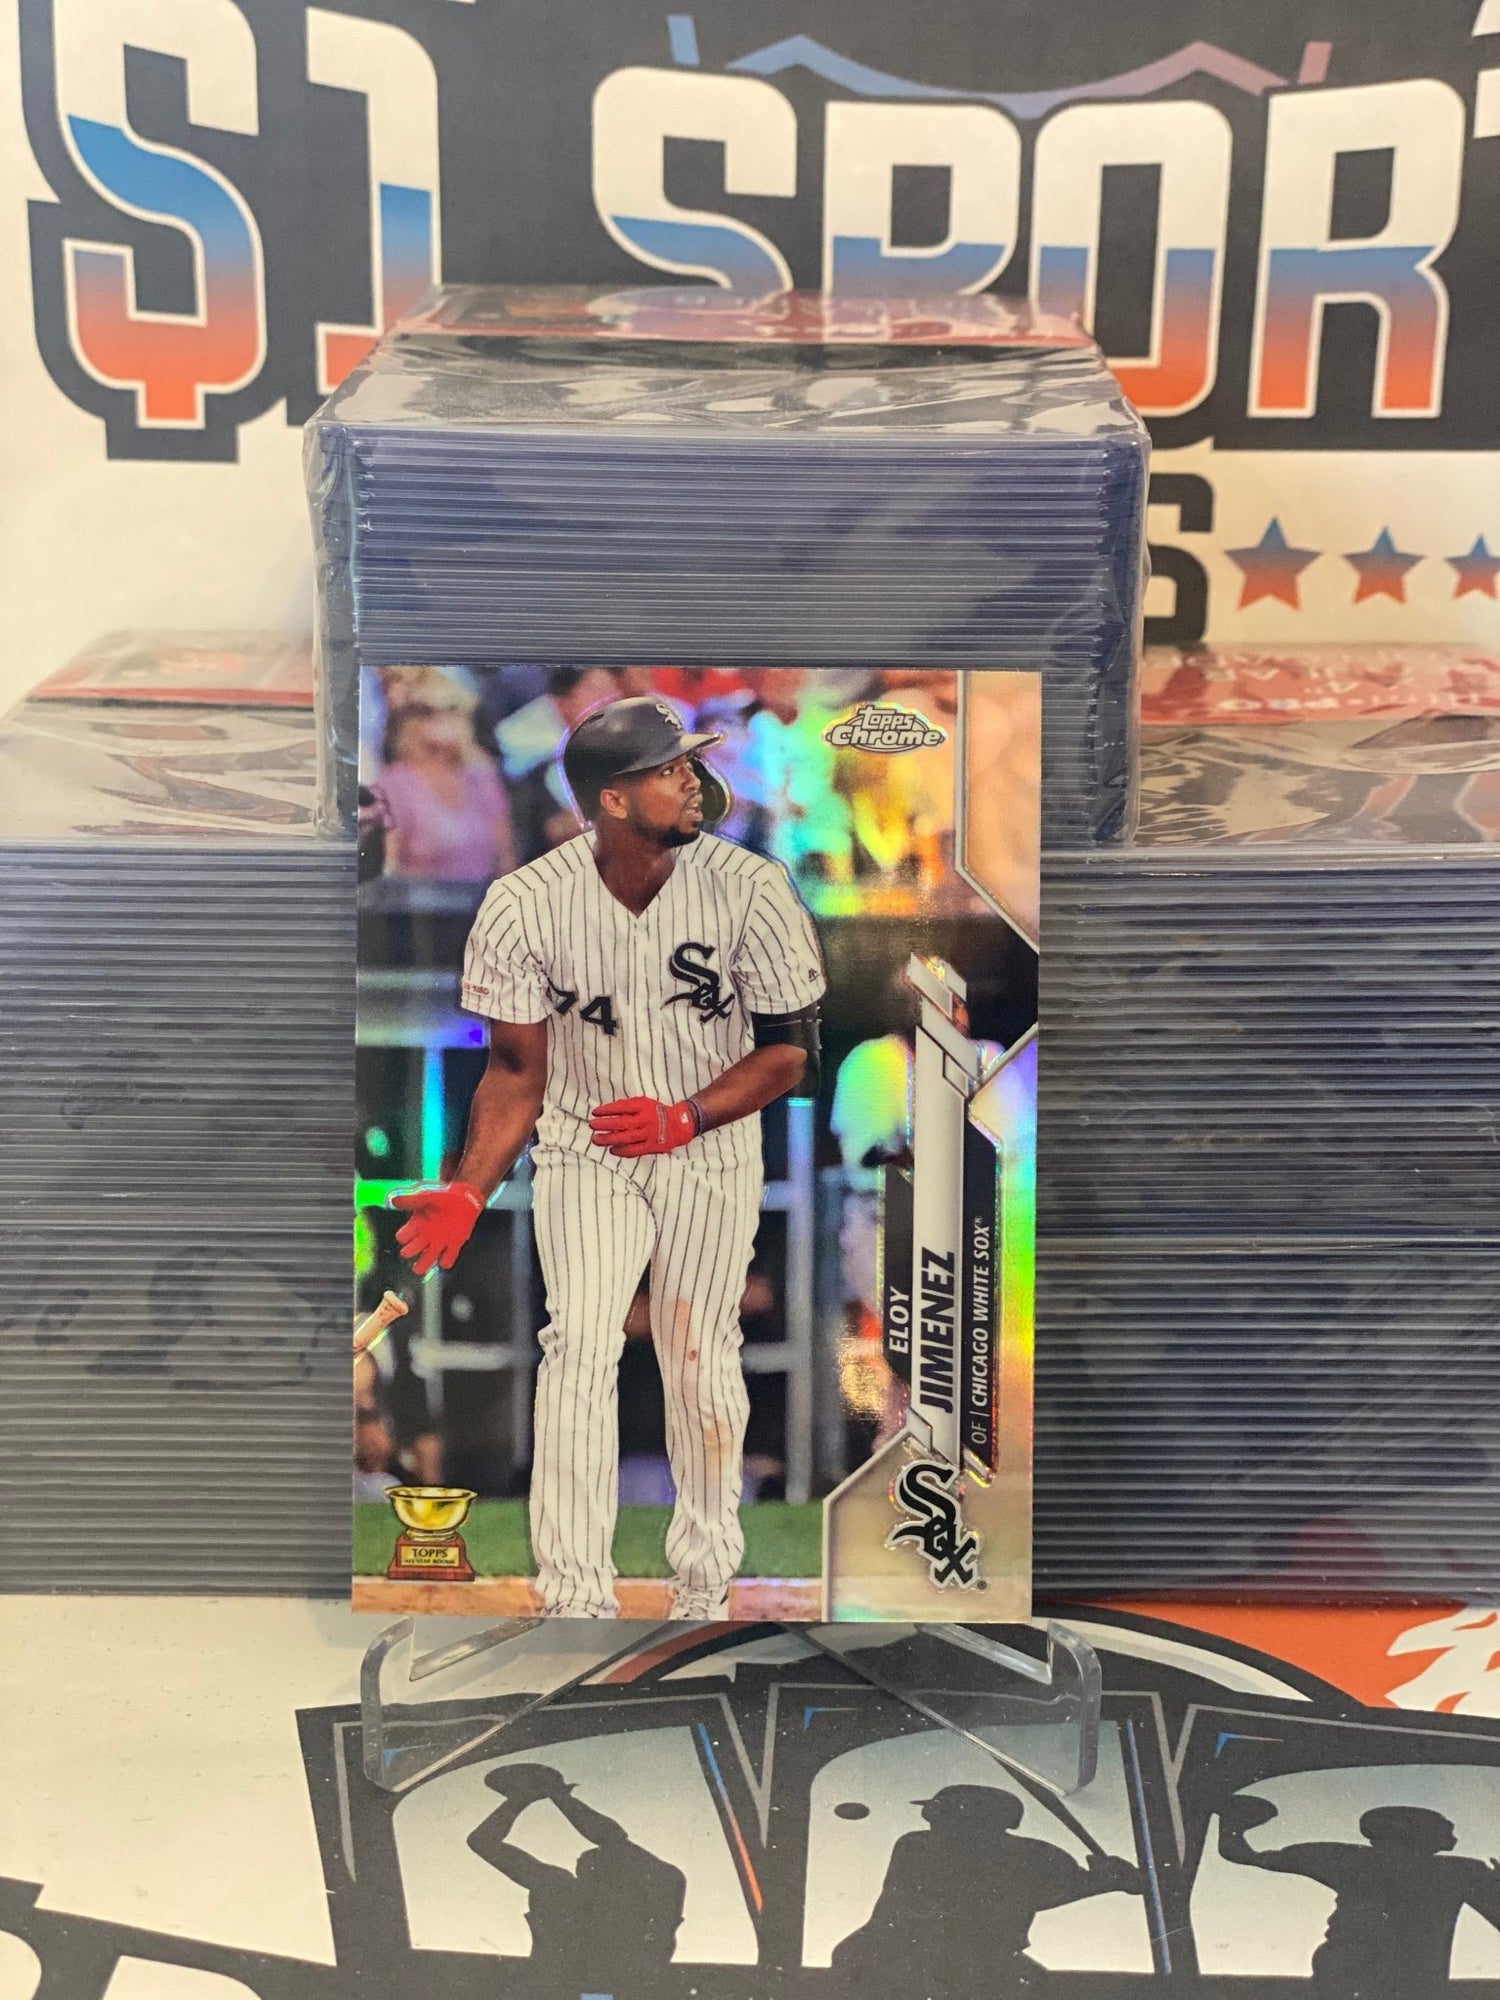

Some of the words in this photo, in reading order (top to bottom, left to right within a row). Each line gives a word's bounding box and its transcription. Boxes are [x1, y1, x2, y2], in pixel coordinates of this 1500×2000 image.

[829, 722, 943, 747] Chrome
[888, 1285, 910, 1355] ELOY
[972, 1264, 990, 1322] WHITE
[919, 1246, 955, 1415] JIMENEZ
[971, 1327, 990, 1408] CHICAGO
[970, 1420, 988, 1445] OF
[411, 1548, 448, 1559] TOPPS
